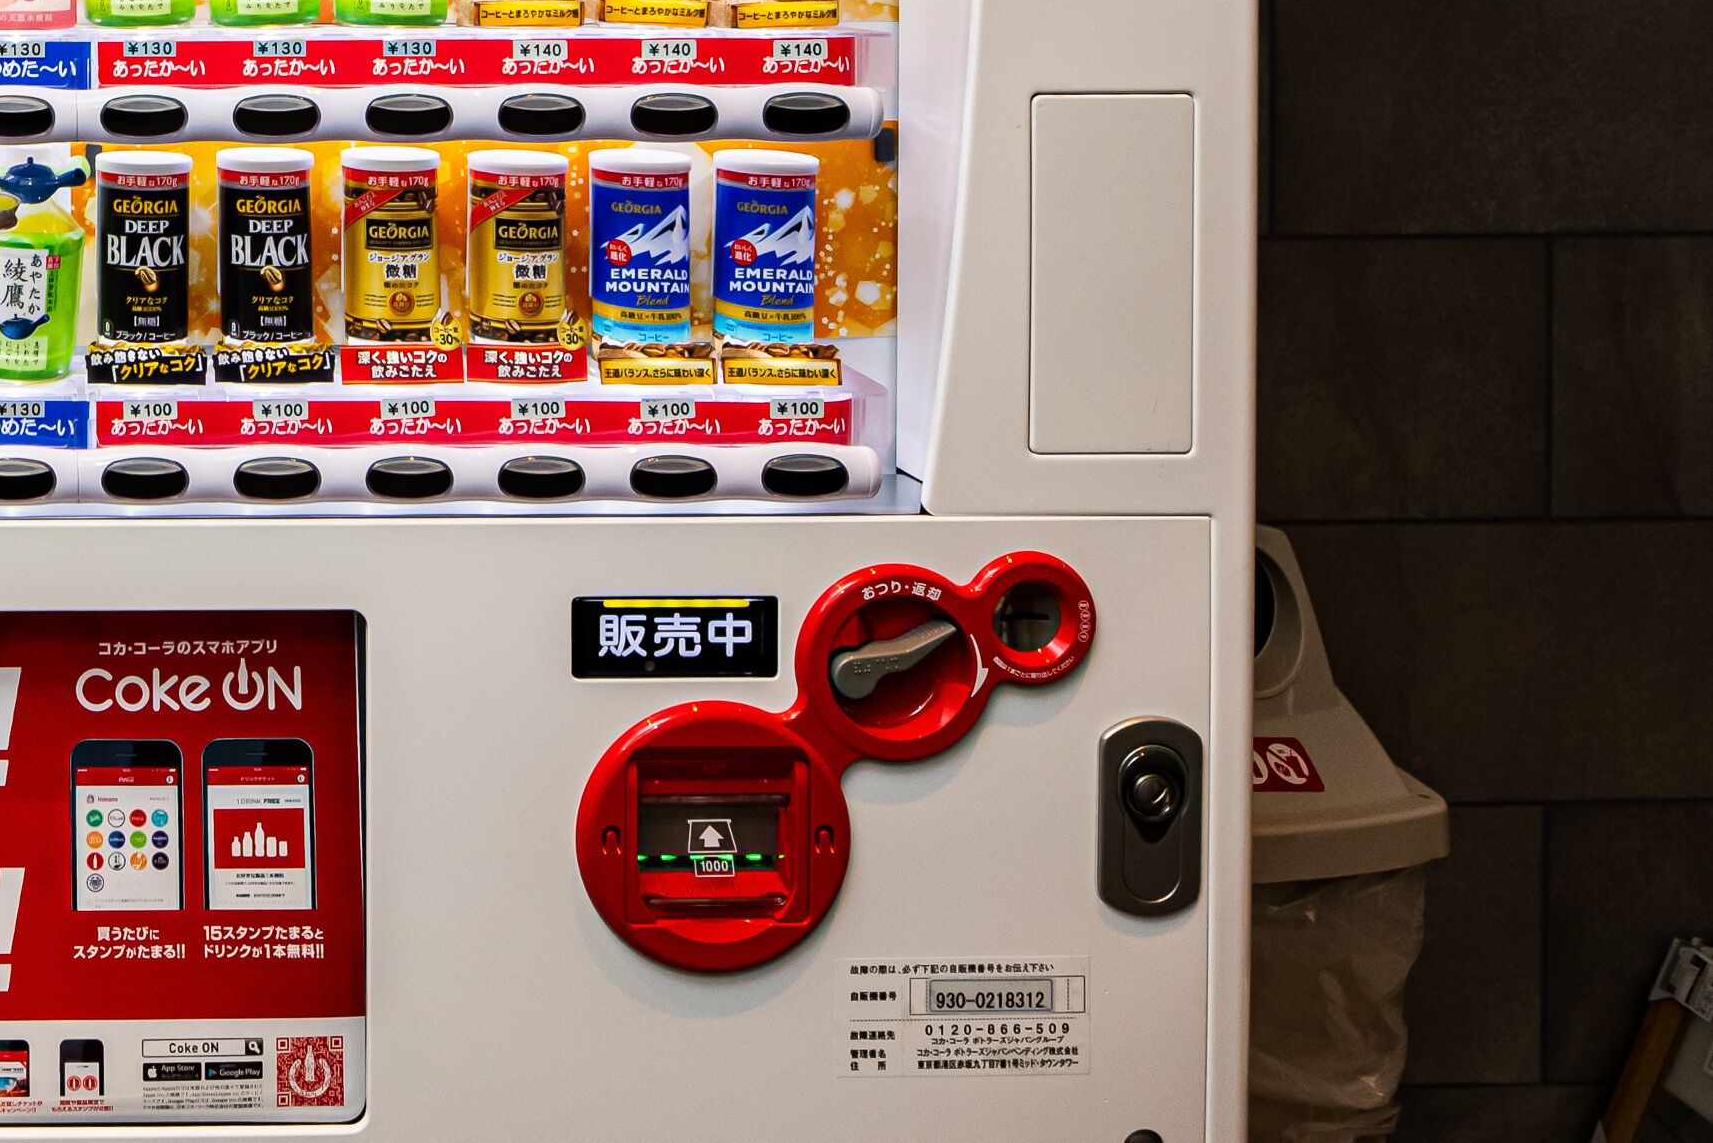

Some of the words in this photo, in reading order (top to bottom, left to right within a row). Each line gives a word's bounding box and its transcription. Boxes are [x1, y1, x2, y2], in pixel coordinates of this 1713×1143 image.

[128, 42, 172, 56] ¥130
[257, 42, 302, 55] ¥130
[387, 42, 432, 56] ¥130
[519, 44, 562, 57] ¥140
[648, 43, 691, 56] ¥140
[780, 43, 822, 56] ¥140
[124, 220, 169, 234] DEEP
[249, 219, 293, 234] DEEP
[107, 234, 185, 266] BLACK
[230, 234, 309, 267] BLACK
[385, 264, 417, 279] 微糖
[515, 263, 546, 279] 微糖
[610, 268, 688, 280] EMERALD
[735, 268, 812, 280] EMERALD
[1, 259, 28, 310] 綾鷹
[606, 280, 690, 293] MOUNTAIN
[729, 280, 814, 294] MOUNTAIN
[636, 294, 670, 307] Blend
[761, 294, 794, 306] Blend
[371, 364, 436, 378] 飲みごたえ
[498, 364, 562, 378] 飲みごたえ
[130, 403, 172, 417] ¥100
[261, 404, 303, 418] ¥100
[388, 400, 430, 415] ¥100
[518, 401, 560, 415] ¥100
[648, 402, 690, 417] ¥100
[777, 402, 819, 415] ¥100
[862, 581, 942, 600] おつり・返却
[598, 612, 753, 659] 販売中
[99, 640, 278, 656] コカ・コーラのスマホアプリ
[75, 667, 211, 712] Coke
[222, 658, 302, 711] ON
[700, 860, 729, 873] 1000
[97, 926, 159, 941] 買うたびに
[203, 925, 324, 941] 15スタンプたまると
[73, 944, 185, 959] スタンプがたまる!!
[204, 944, 324, 959] ドリンクが1本無料!!
[850, 963, 1054, 975] 故障の際は、必ず下記の自販機番号をお伝え下さい
[850, 991, 897, 1001] 自販機番号
[936, 992, 1045, 1009] 930-0218312
[850, 1030, 896, 1041] 故障連絡先
[169, 1042, 198, 1053] Coke
[202, 1042, 219, 1053] ON
[850, 1049, 887, 1059] 管理者名
[219, 1069, 244, 1077] Google
[877, 1061, 887, 1071] 所
